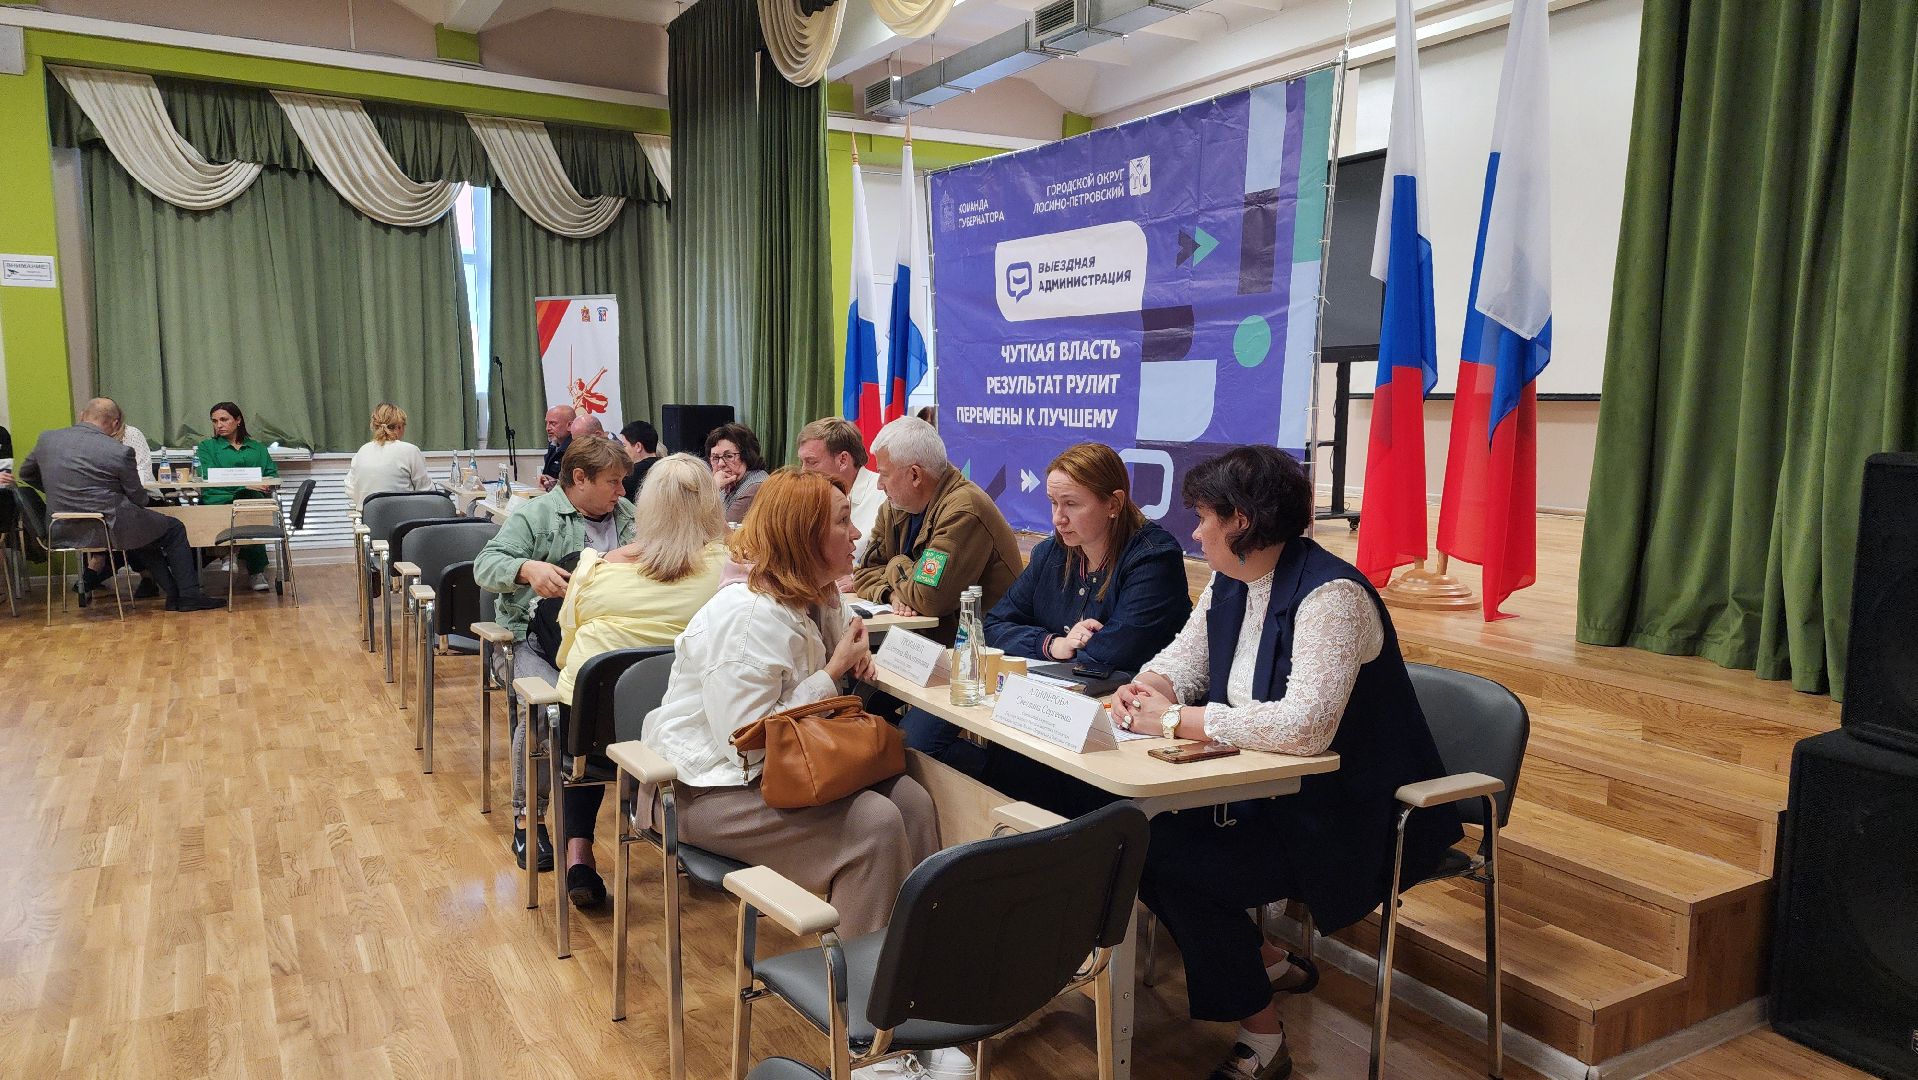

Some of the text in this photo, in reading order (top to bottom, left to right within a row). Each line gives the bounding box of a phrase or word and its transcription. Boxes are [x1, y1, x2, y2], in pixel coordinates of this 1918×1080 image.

[1046, 167, 1125, 196] ГОРОДСКОЙ ОКРУГ
[959, 199, 989, 215] КОМАНДА
[1033, 183, 1125, 214] ЛОСИНО-ПЕТРОВСКИЙ
[959, 210, 1005, 229] ГУБЕРНАТОРА
[1038, 256, 1096, 274] ВЫЕЗДНАЯ
[1038, 269, 1132, 293] АДМИНИСТРАЦИЯ
[1001, 339, 1121, 364] ЧУТКАЯ ВЛАСТЬ
[986, 374, 1121, 395] РЕЗУЛЬТАТ РУЛИТ
[956, 406, 1119, 429] ПЕРЕМЕНЫ К ЛУЧШЕМУ
